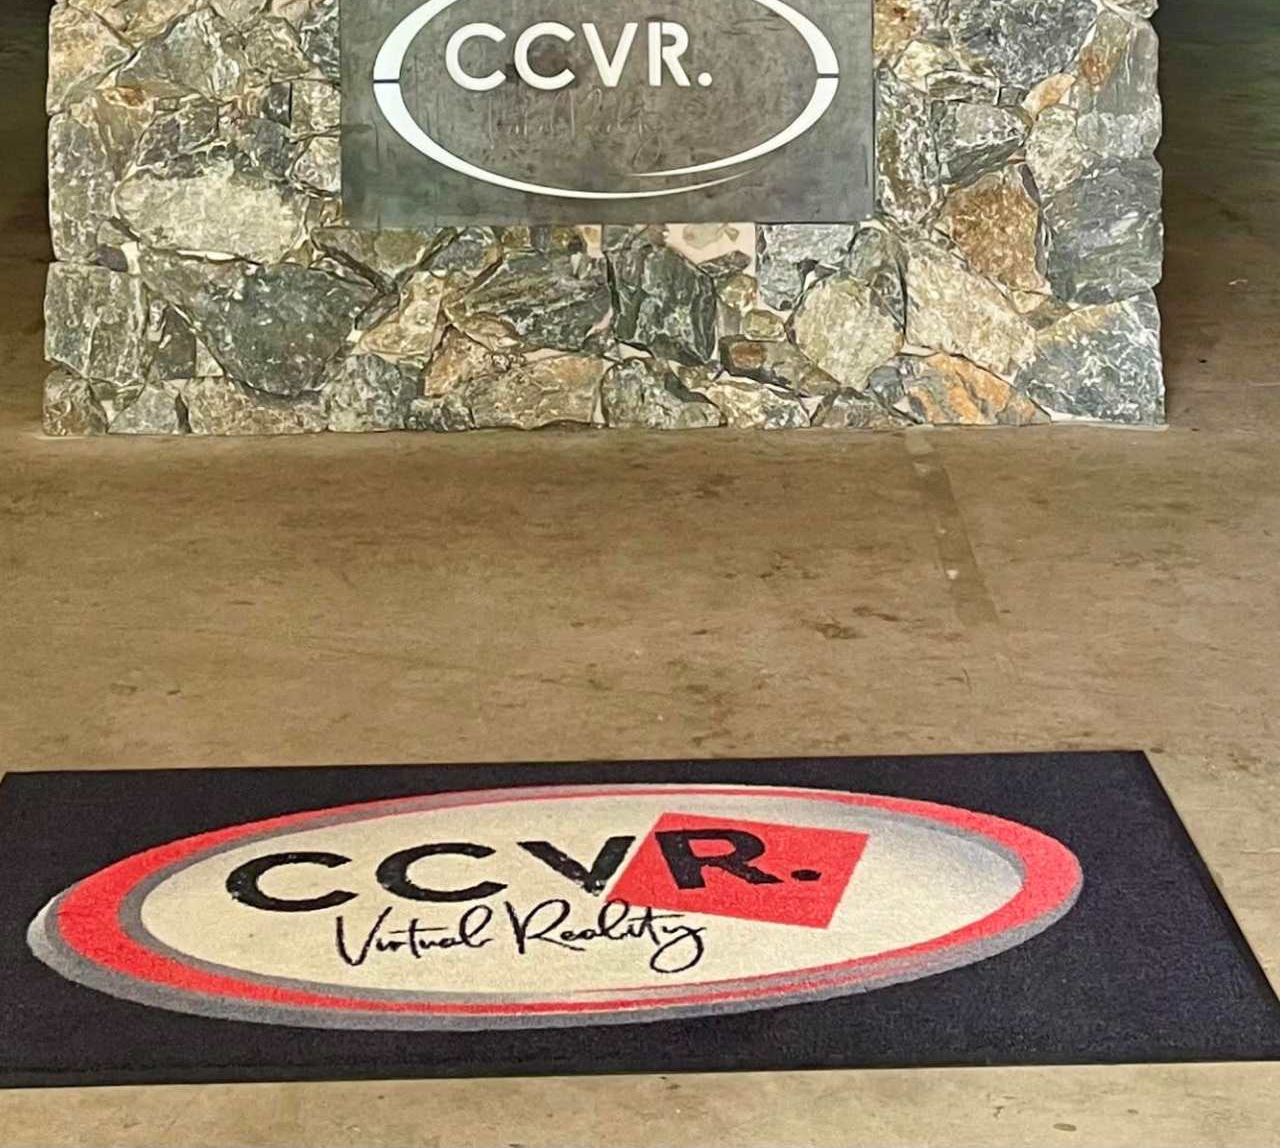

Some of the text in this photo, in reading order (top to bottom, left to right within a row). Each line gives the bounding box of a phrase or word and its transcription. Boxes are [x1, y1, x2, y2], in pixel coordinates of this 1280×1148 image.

[445, 21, 713, 92] CCVR.
[226, 829, 821, 912] CCVR.
[334, 899, 708, 974] Virtual Reality
